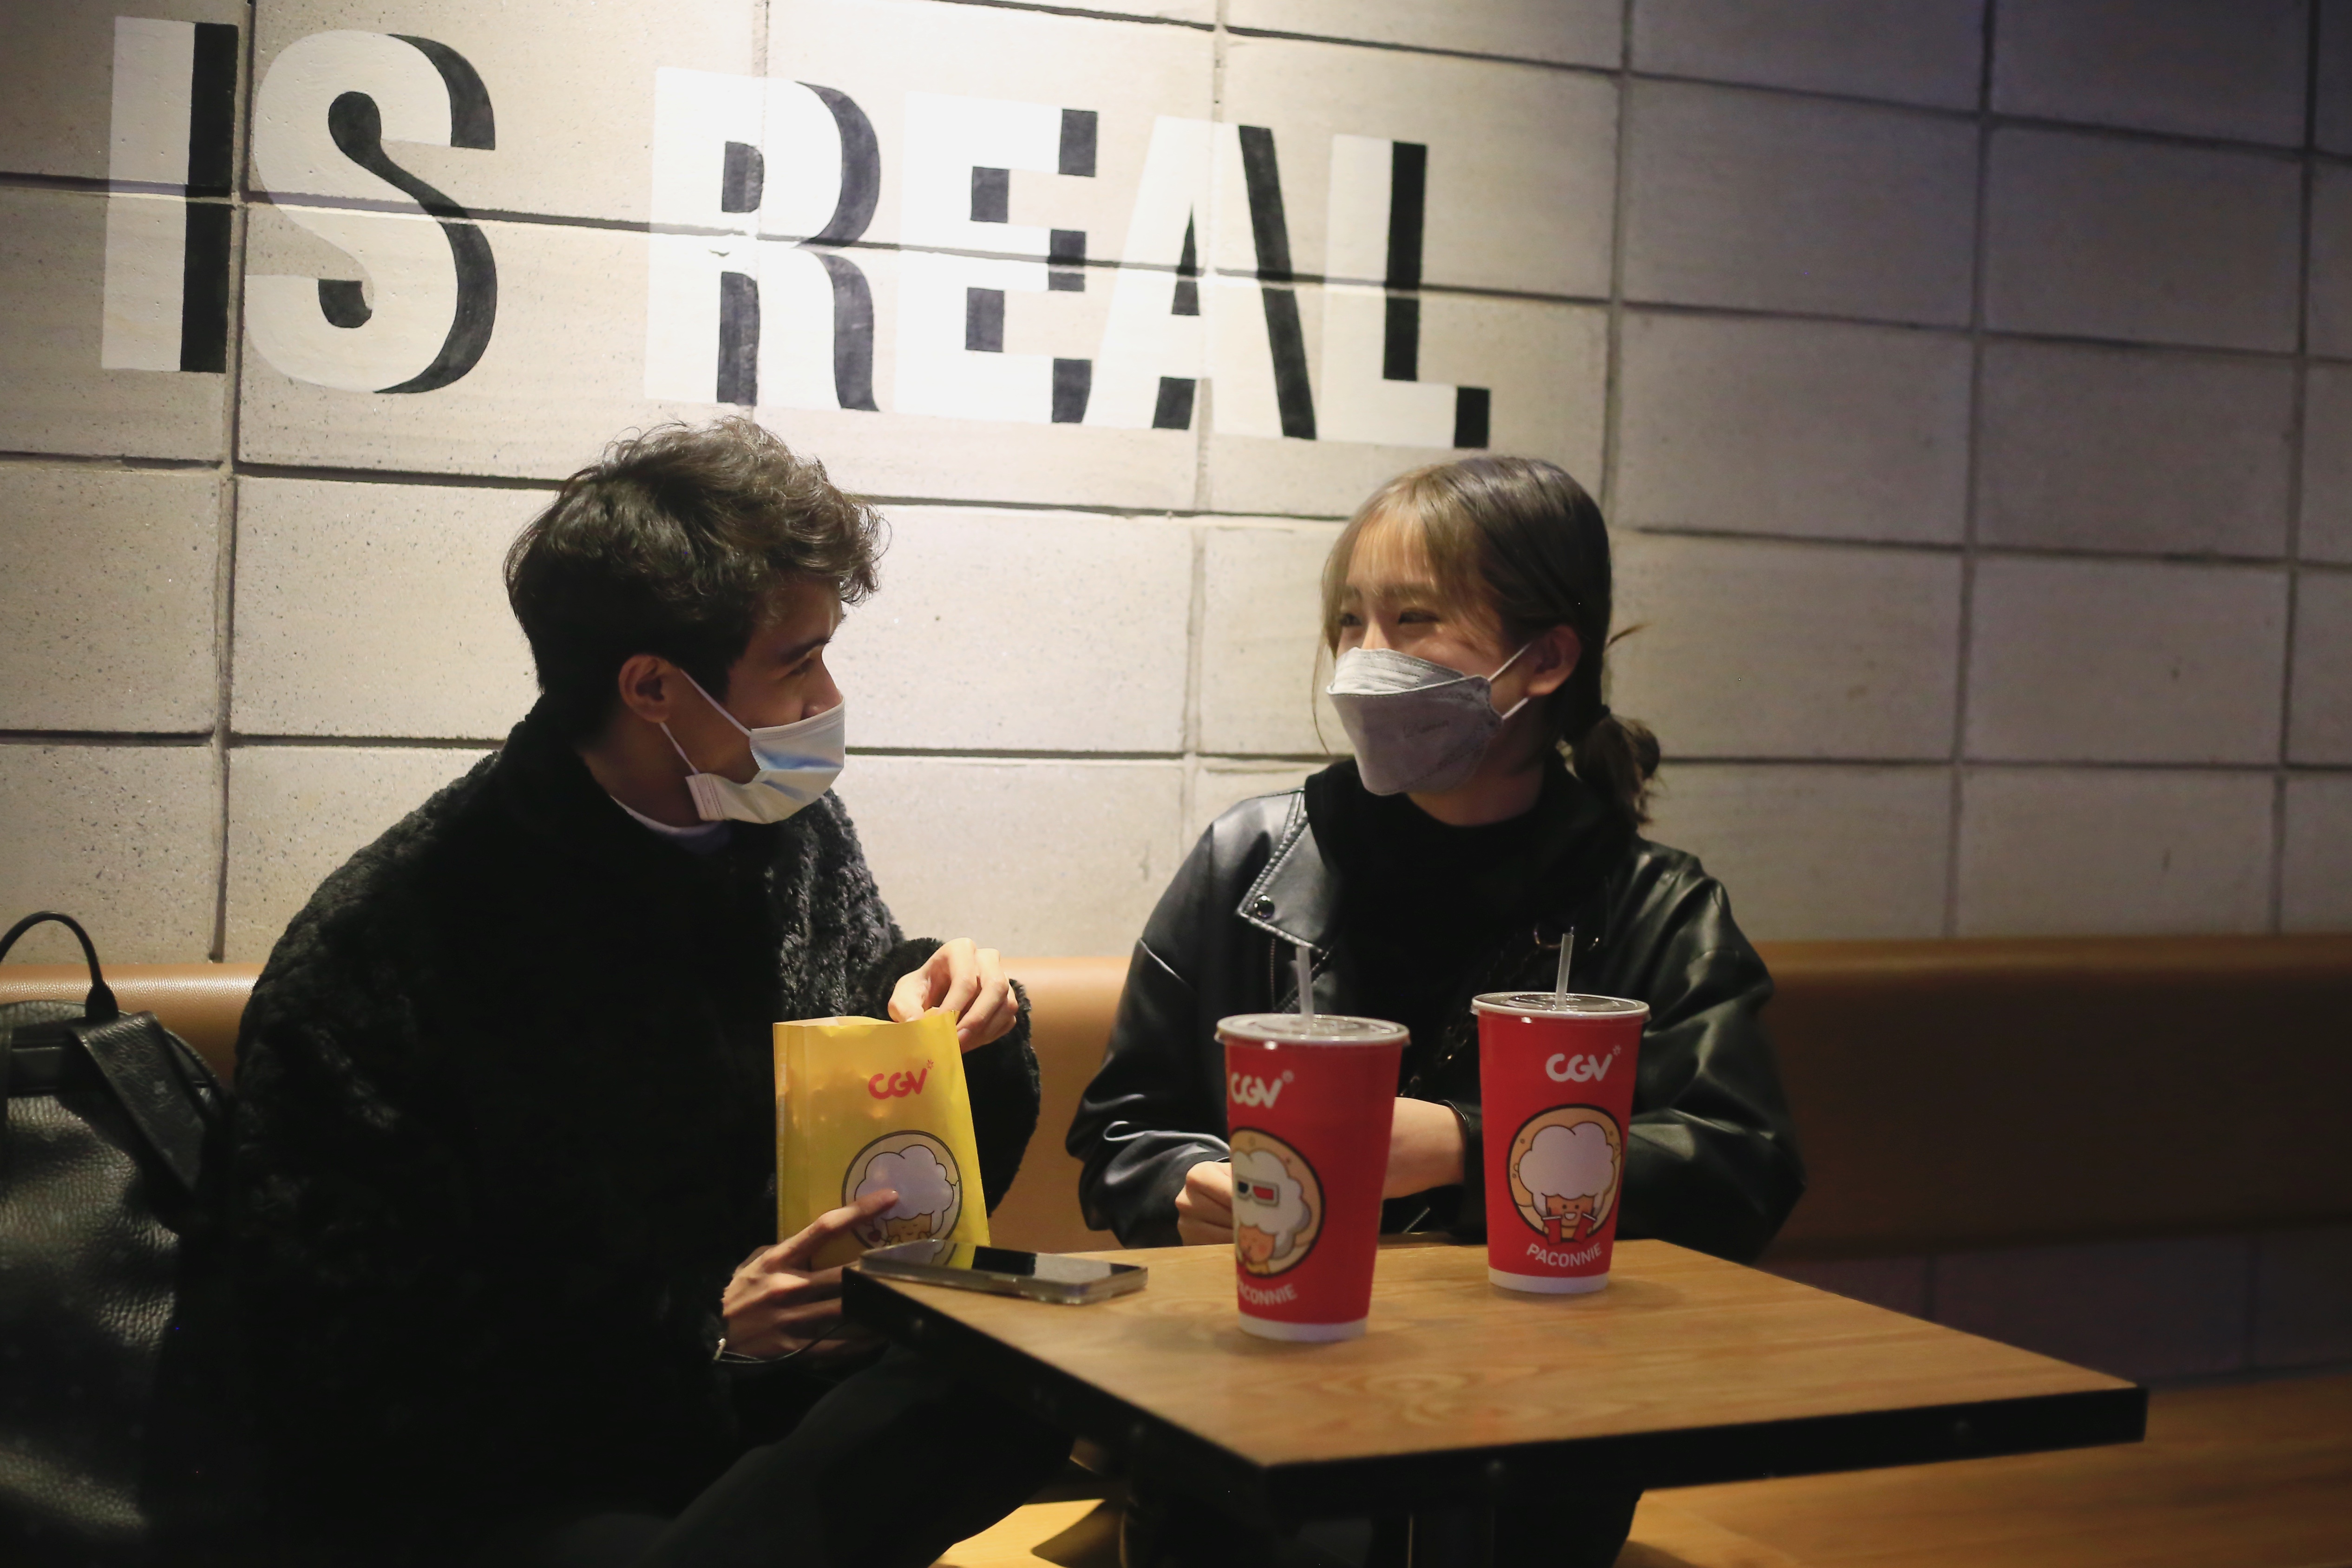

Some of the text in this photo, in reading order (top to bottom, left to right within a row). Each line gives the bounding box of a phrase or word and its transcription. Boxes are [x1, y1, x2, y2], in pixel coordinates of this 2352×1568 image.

[101, 16, 1491, 448] IS REAL
[868, 1068, 927, 1100] CGV
[1546, 1053, 1613, 1083] CGV
[1230, 1071, 1283, 1109] CGV
[1526, 1242, 1602, 1267] PACONNIE
